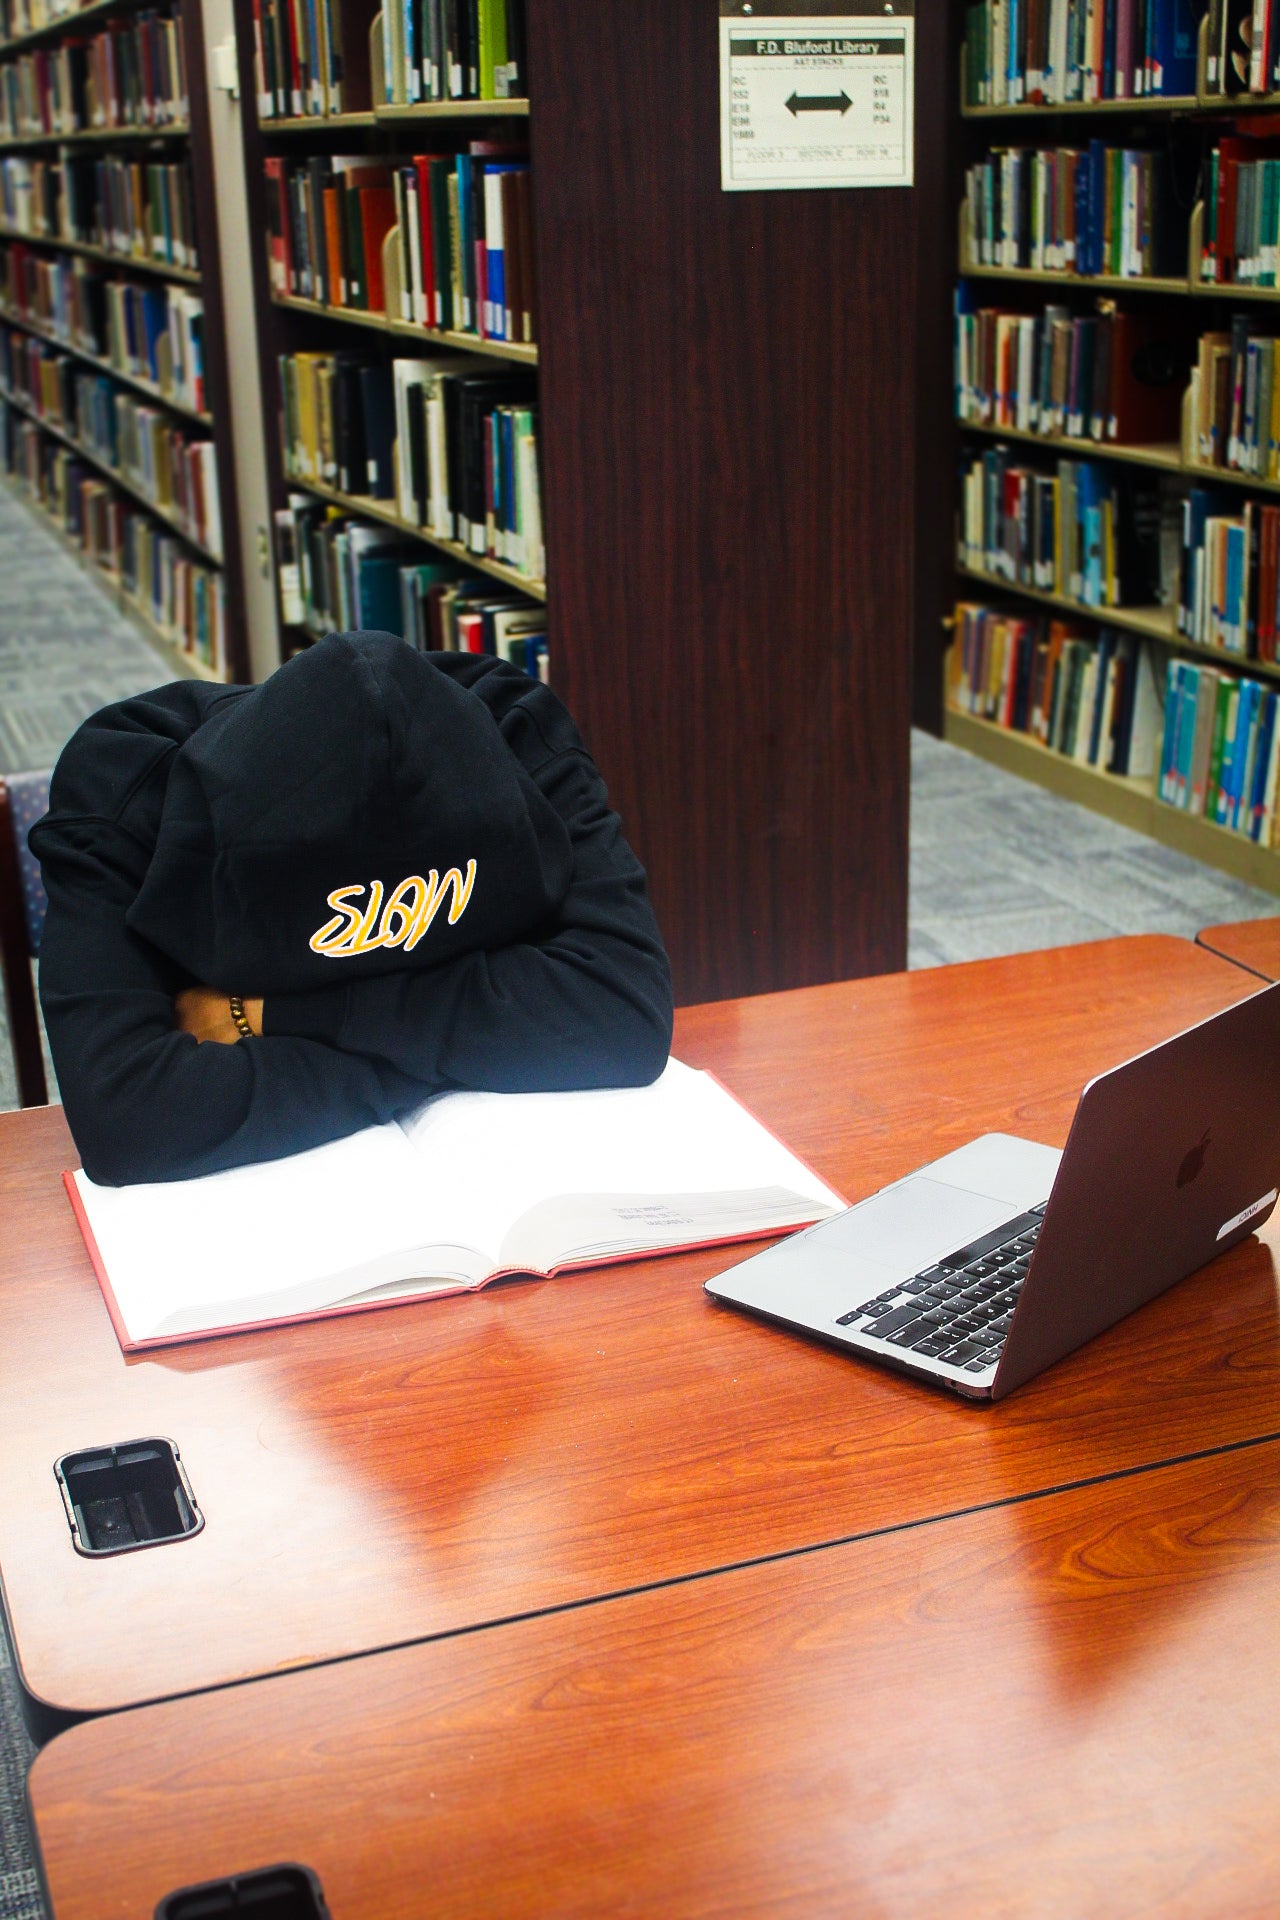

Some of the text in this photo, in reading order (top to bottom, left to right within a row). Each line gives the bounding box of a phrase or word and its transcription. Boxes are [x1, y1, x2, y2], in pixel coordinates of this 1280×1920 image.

[757, 41, 880, 55] F.D. Bluford Library
